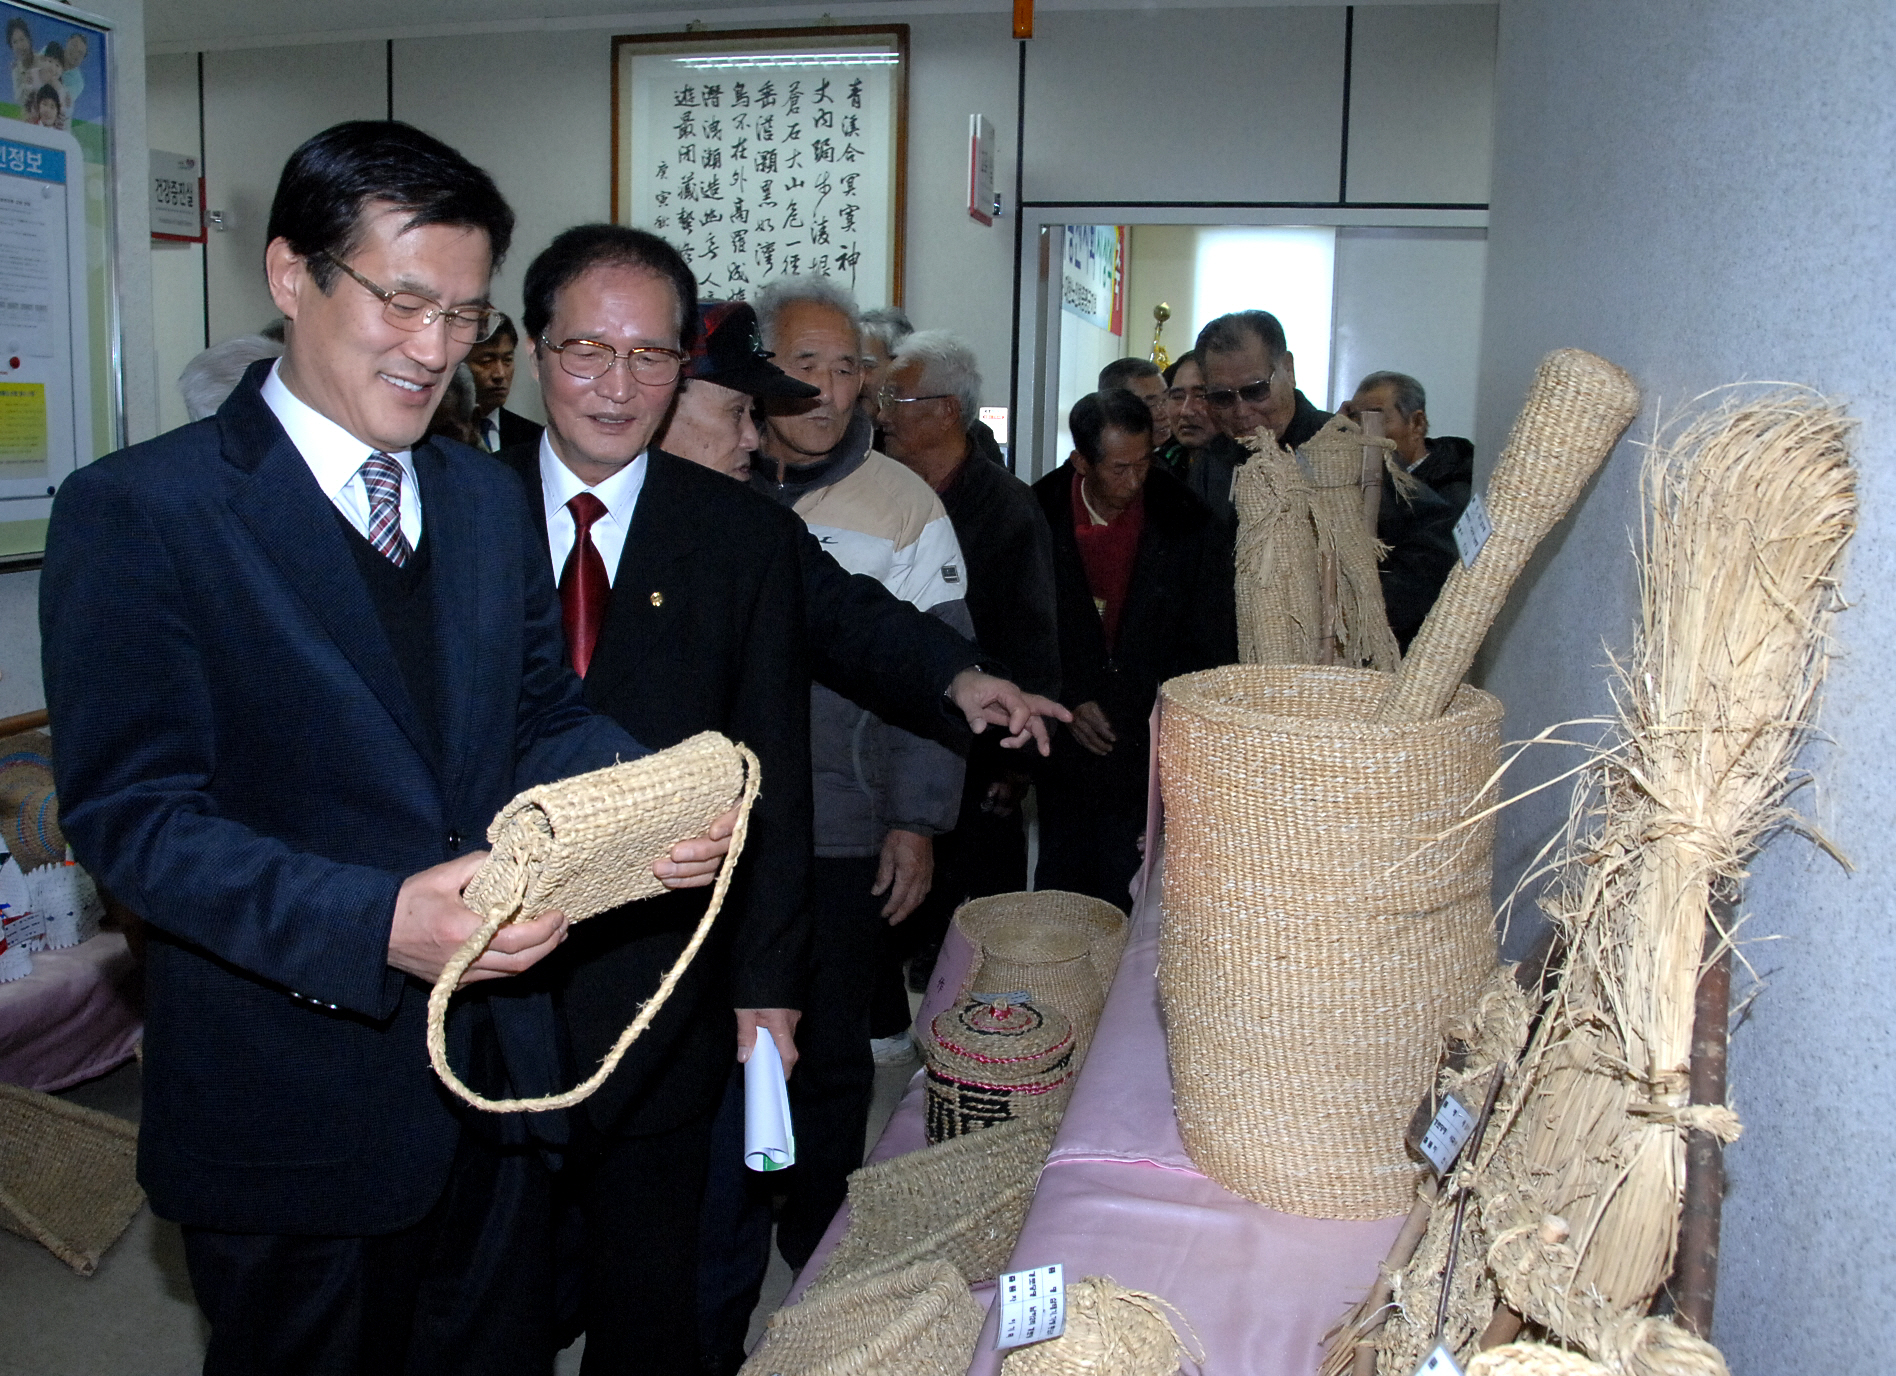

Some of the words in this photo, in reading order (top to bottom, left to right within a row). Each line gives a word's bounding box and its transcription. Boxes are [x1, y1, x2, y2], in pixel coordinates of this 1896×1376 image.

[155, 178, 194, 208] 건강증진실
[654, 160, 673, 239] 庚寅秋
